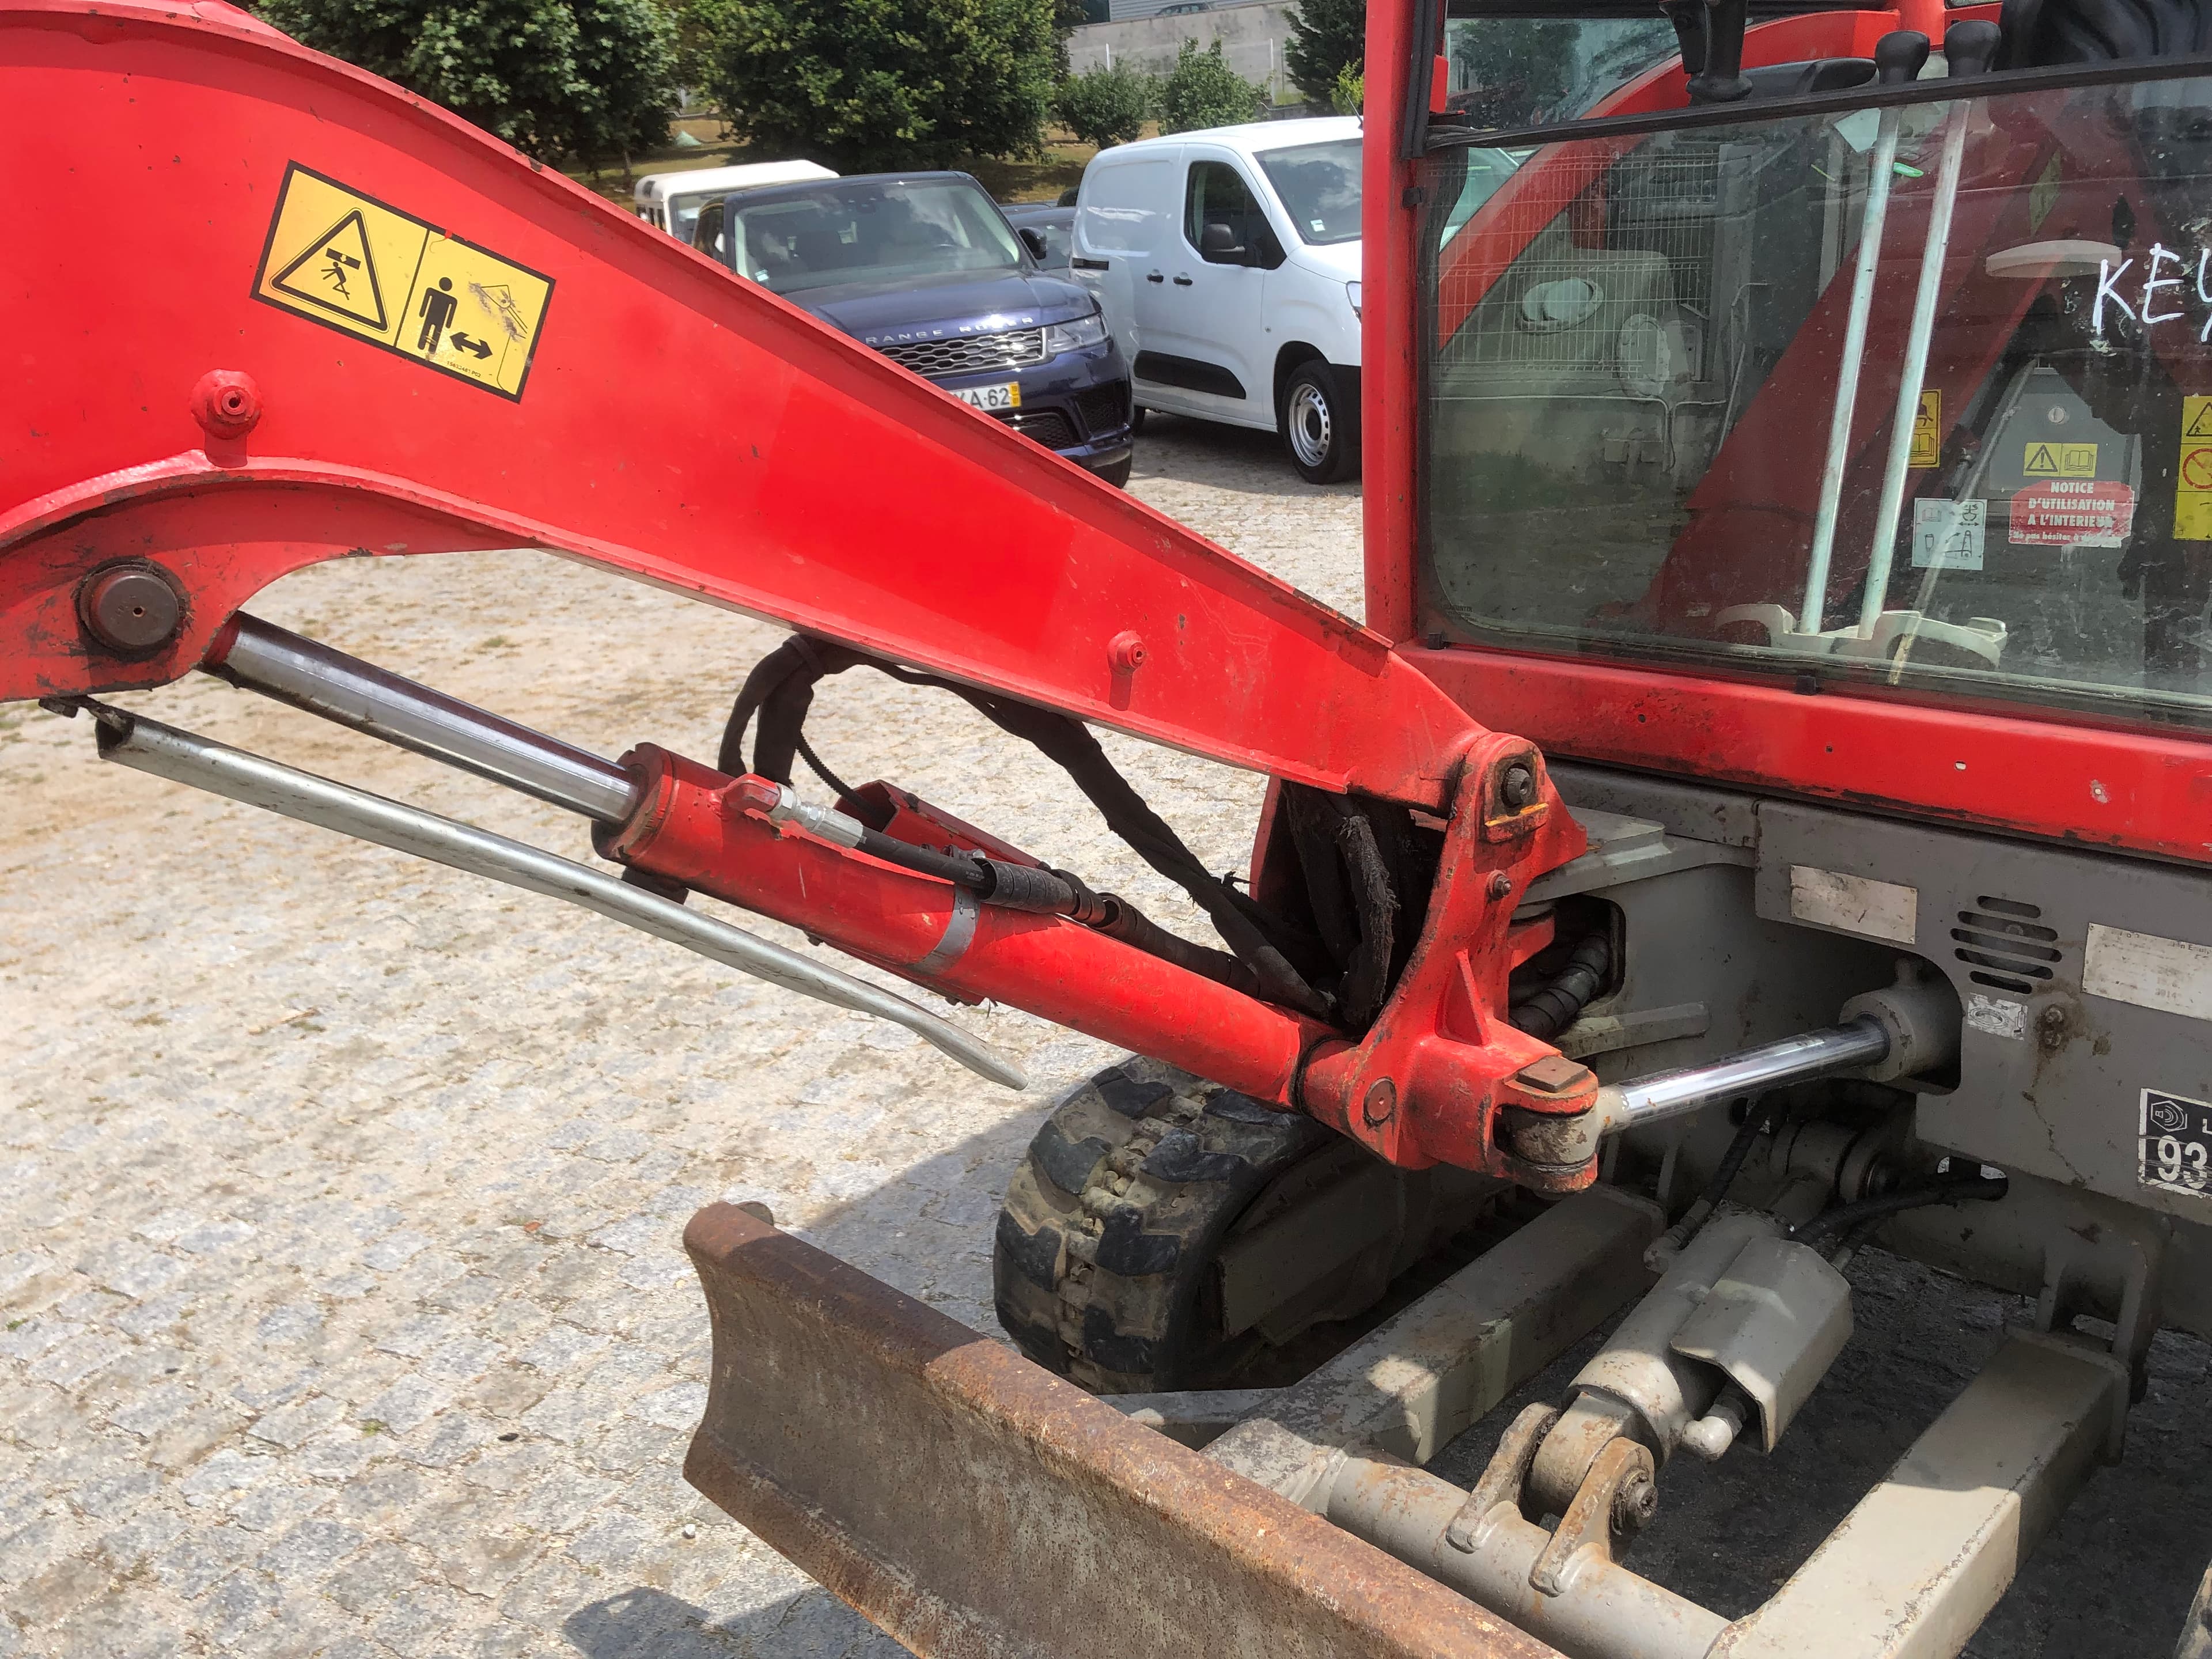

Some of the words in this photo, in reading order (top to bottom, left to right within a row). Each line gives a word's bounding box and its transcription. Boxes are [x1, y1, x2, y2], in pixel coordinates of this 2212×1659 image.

[865, 329, 944, 344] RANGE
[959, 317, 1034, 333] ROR
[2051, 482, 2094, 494] NOTICE
[2028, 497, 2115, 511] D'UTILISATION
[2027, 514, 2036, 525] A
[2040, 514, 2113, 528] L'INTERIEUR
[2158, 1135, 2208, 1190] 93
